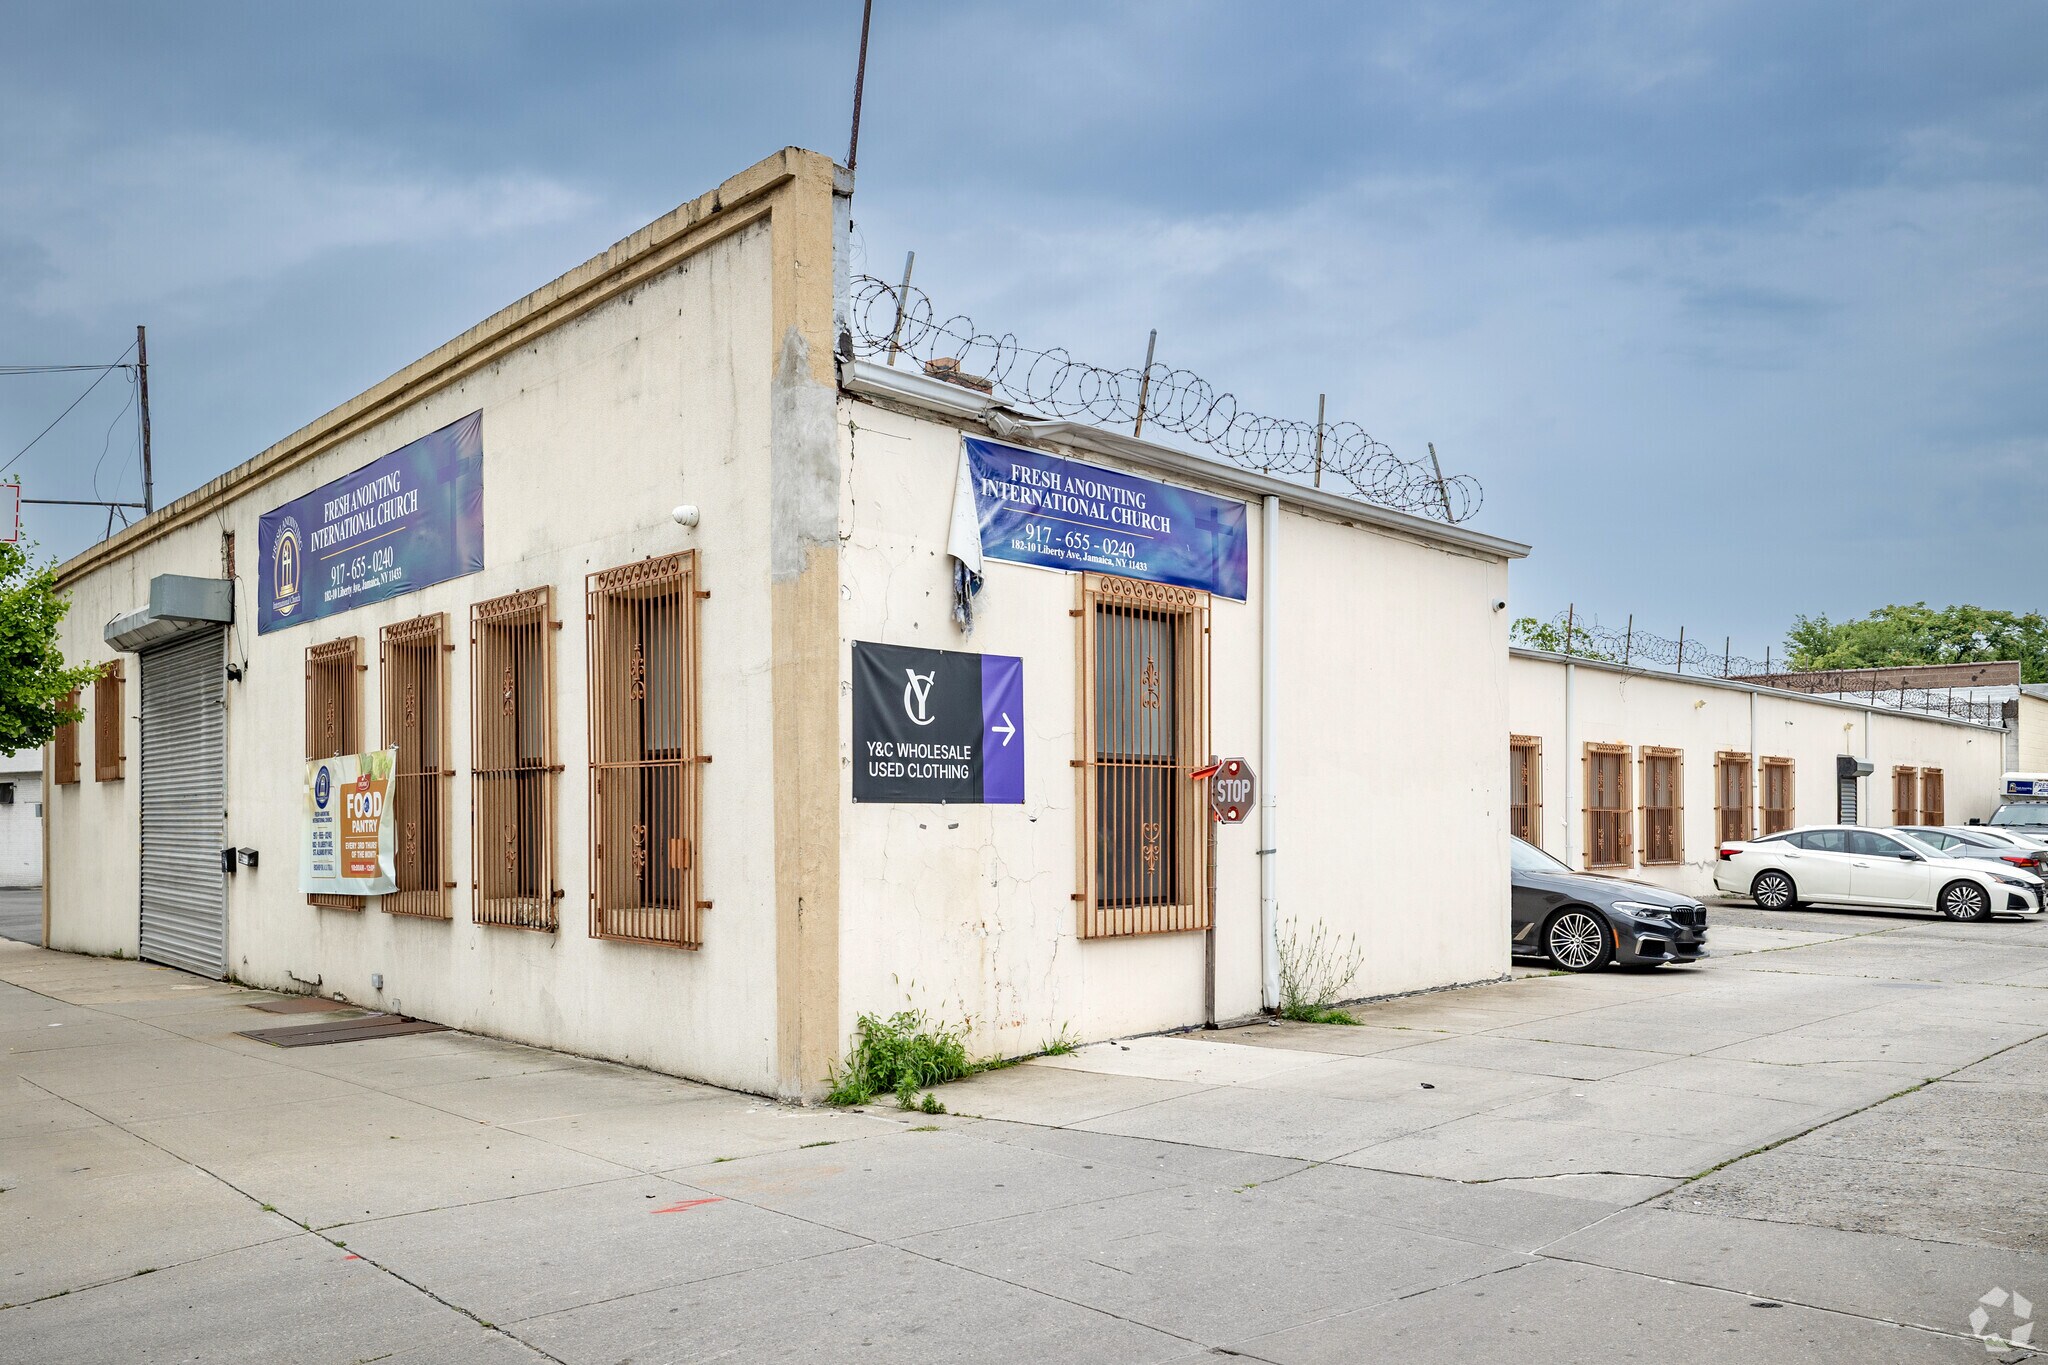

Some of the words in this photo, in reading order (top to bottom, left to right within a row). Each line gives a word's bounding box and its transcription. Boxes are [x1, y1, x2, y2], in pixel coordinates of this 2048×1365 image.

[324, 493, 350, 523] FRESH
[350, 470, 400, 512] ANOINTING
[1011, 464, 1061, 491] FRESH
[1064, 477, 1146, 510] ANOINTING
[311, 507, 376, 552] INTERNATIONAL
[377, 489, 418, 525] CHURCH
[982, 478, 1109, 521] INTERNATIONAL
[1111, 507, 1171, 534] CHURCH
[1011, 539, 1036, 552] 182-10
[1037, 544, 1065, 559] Liberty
[1066, 550, 1082, 562] Ave,
[1083, 553, 1114, 567] Jamaica,
[1115, 558, 1128, 568] NY
[1128, 560, 1148, 571] 11433
[1025, 523, 1052, 544] 917
[1065, 531, 1090, 550] 655
[1102, 538, 1135, 559] 0240
[331, 563, 345, 587] 917
[351, 555, 366, 580] 655
[372, 546, 394, 573] 0240
[337, 585, 352, 598] Liberty
[380, 570, 390, 584] NY
[866, 740, 894, 757] Y&C
[896, 742, 971, 760] WHOLESALE
[869, 761, 905, 778] USED
[907, 763, 969, 779] CLOTHING
[346, 791, 383, 819] FOOD
[1217, 779, 1251, 803] STOP
[352, 819, 378, 834] PANTRY
